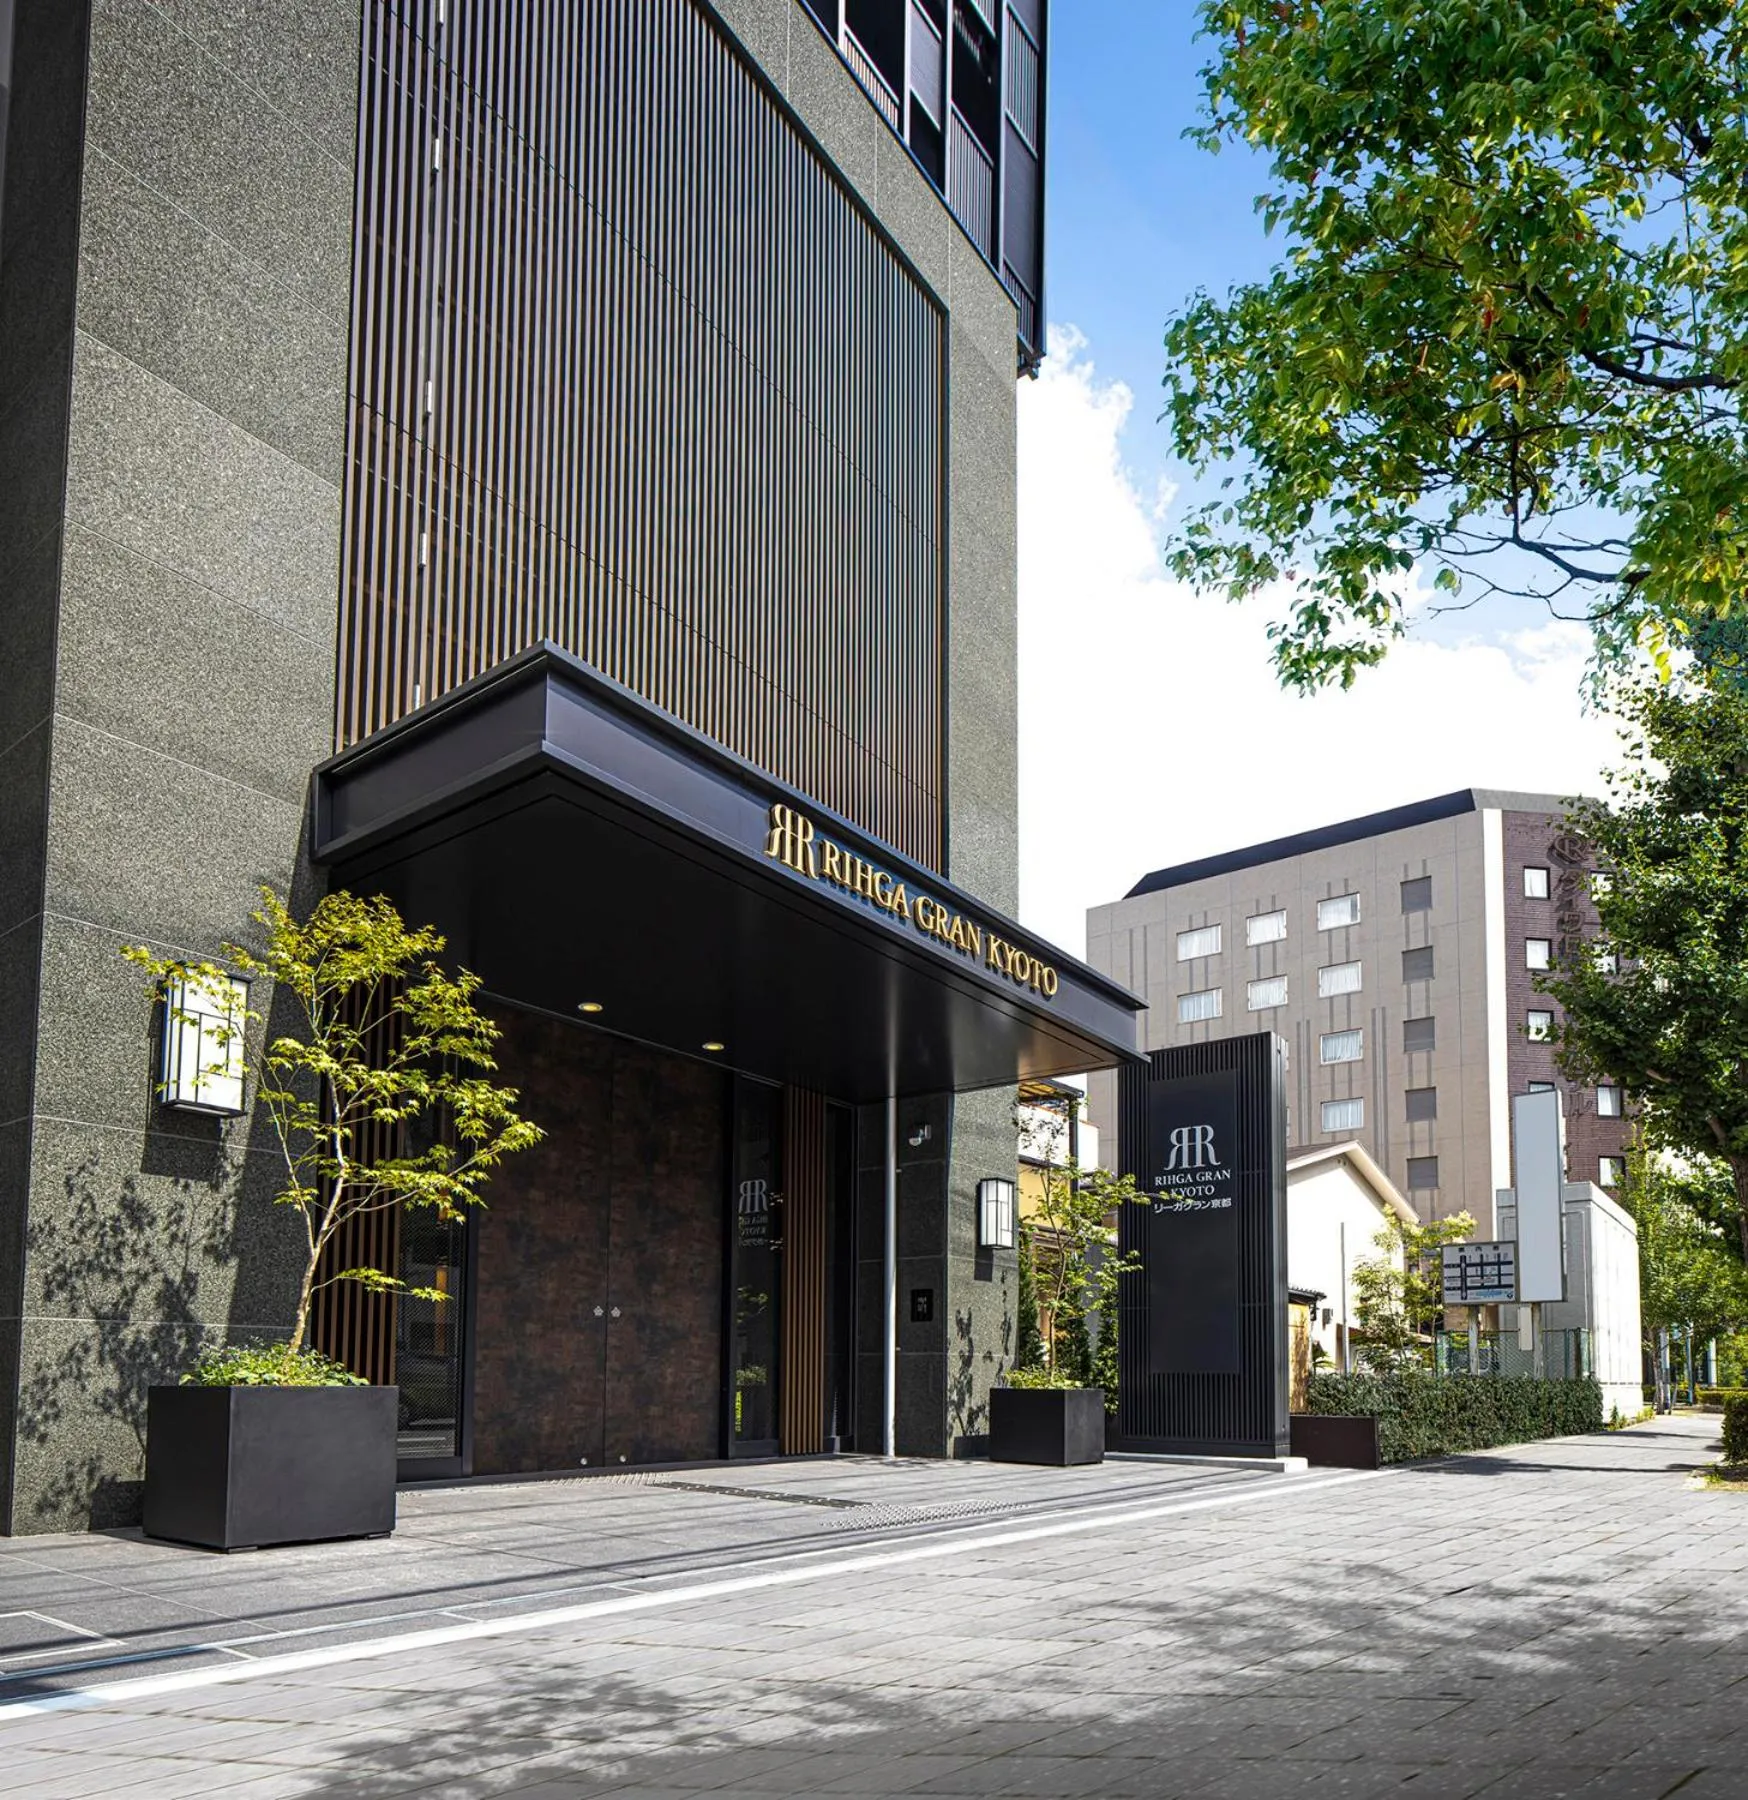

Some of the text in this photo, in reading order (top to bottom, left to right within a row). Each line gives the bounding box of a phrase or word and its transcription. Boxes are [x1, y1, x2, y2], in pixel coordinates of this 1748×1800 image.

[821, 840, 1058, 997] RIHGA GRAN KYOTO
[1155, 1169, 1231, 1186] RIHGA GRAN
[1171, 1185, 1215, 1197] KYOTO
